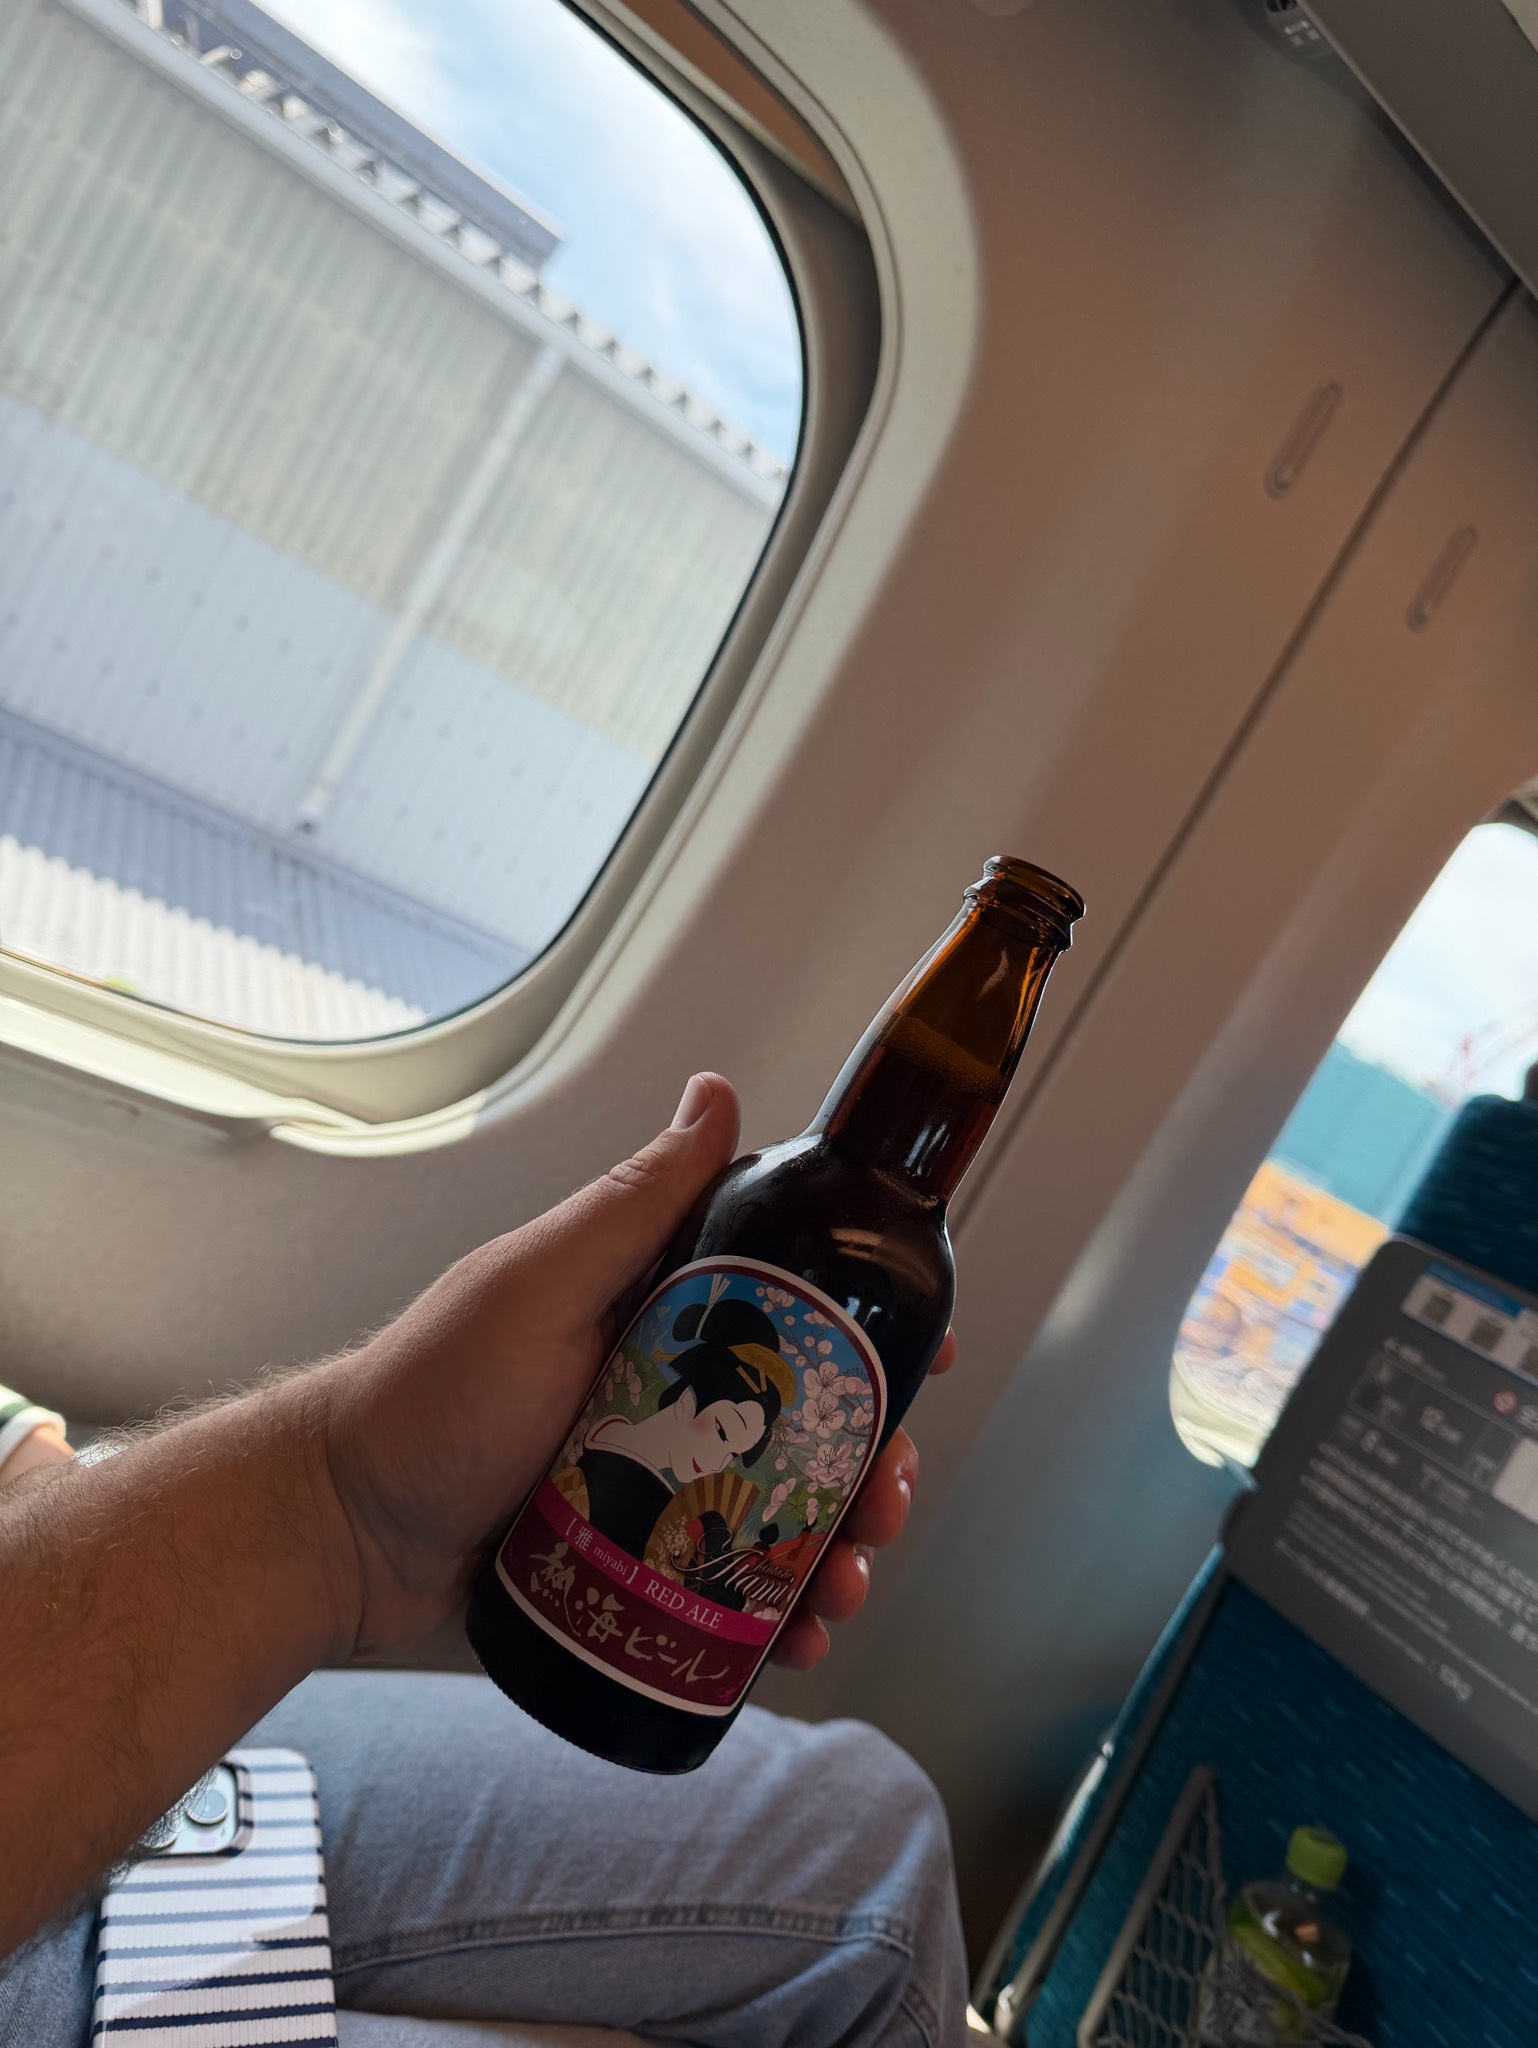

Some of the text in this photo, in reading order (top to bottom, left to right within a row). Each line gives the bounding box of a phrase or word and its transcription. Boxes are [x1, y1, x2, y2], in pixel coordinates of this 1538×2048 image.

[644, 1579, 685, 1611] RED
[685, 1604, 723, 1629] ALE
[671, 1527, 795, 1604] Atami
[529, 1542, 731, 1683] 熱海ビール
